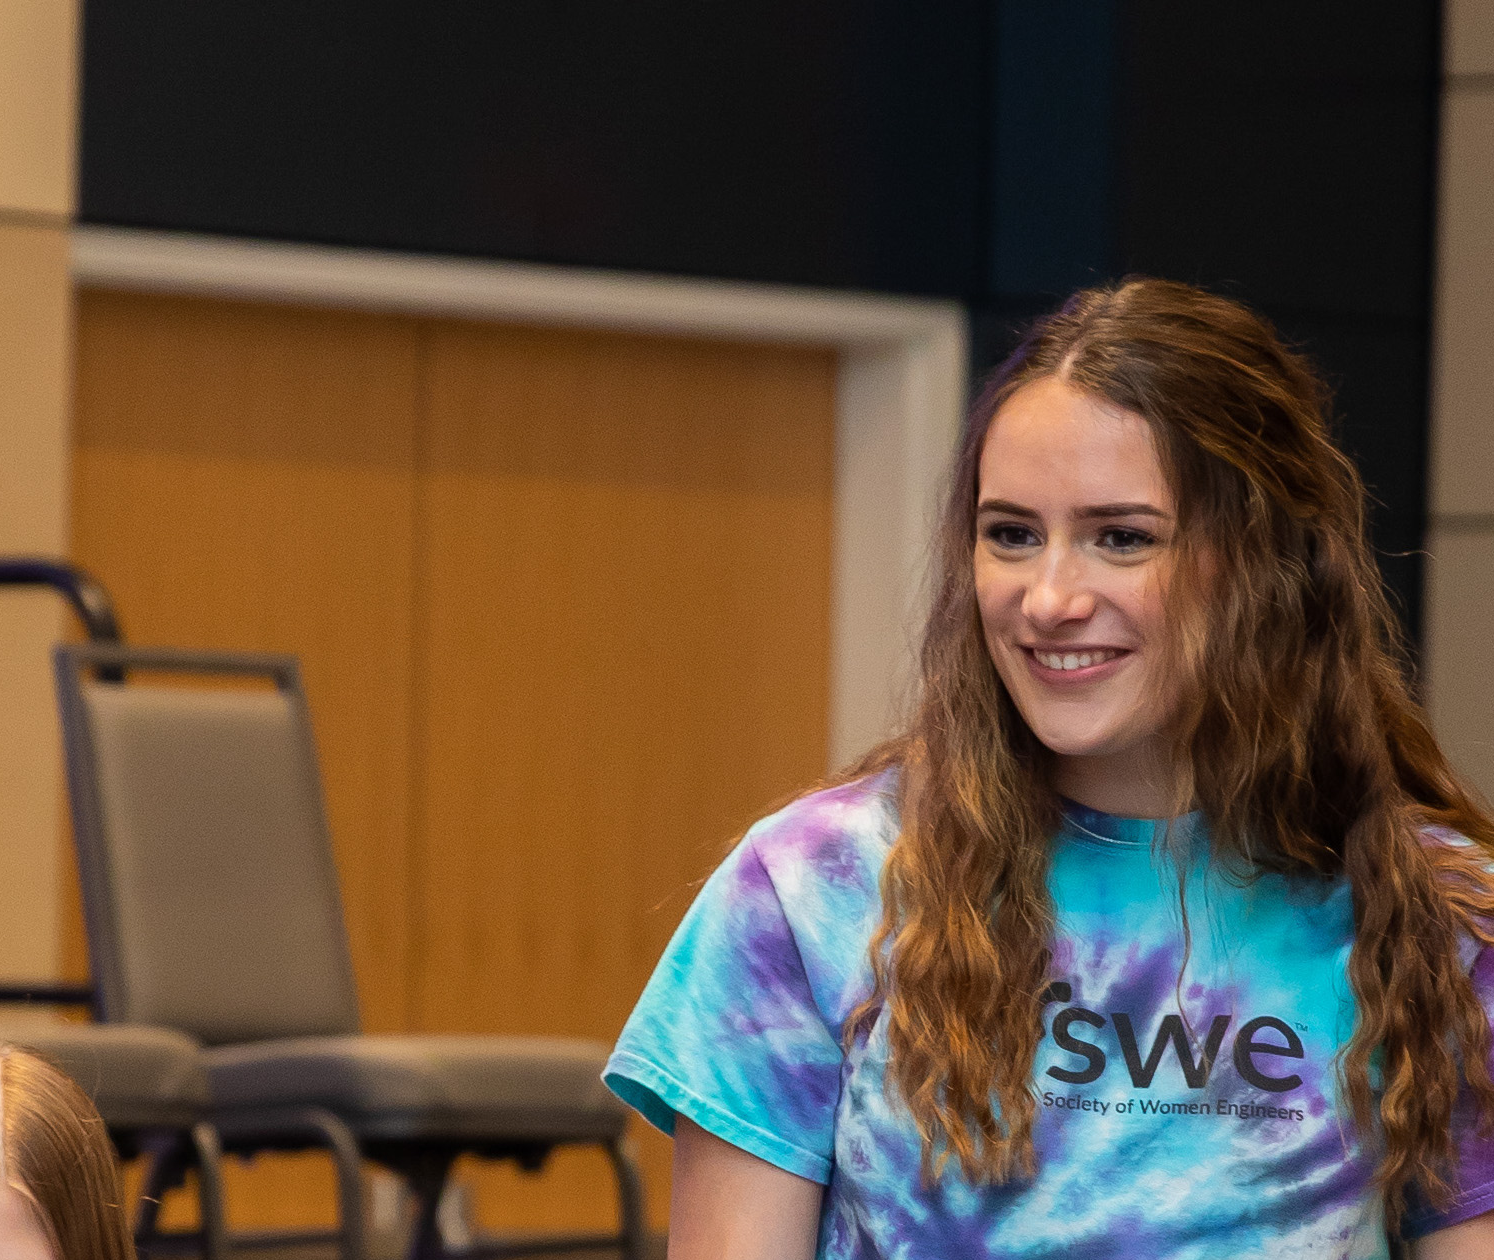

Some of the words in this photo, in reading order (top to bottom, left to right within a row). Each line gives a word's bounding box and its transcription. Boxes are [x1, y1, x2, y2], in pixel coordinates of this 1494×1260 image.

[1045, 1006, 1305, 1093] swe
[1043, 1091, 1110, 1116] Society
[1115, 1098, 1134, 1115] of
[1140, 1099, 1210, 1116] Women
[1216, 1099, 1304, 1121] Engineers
